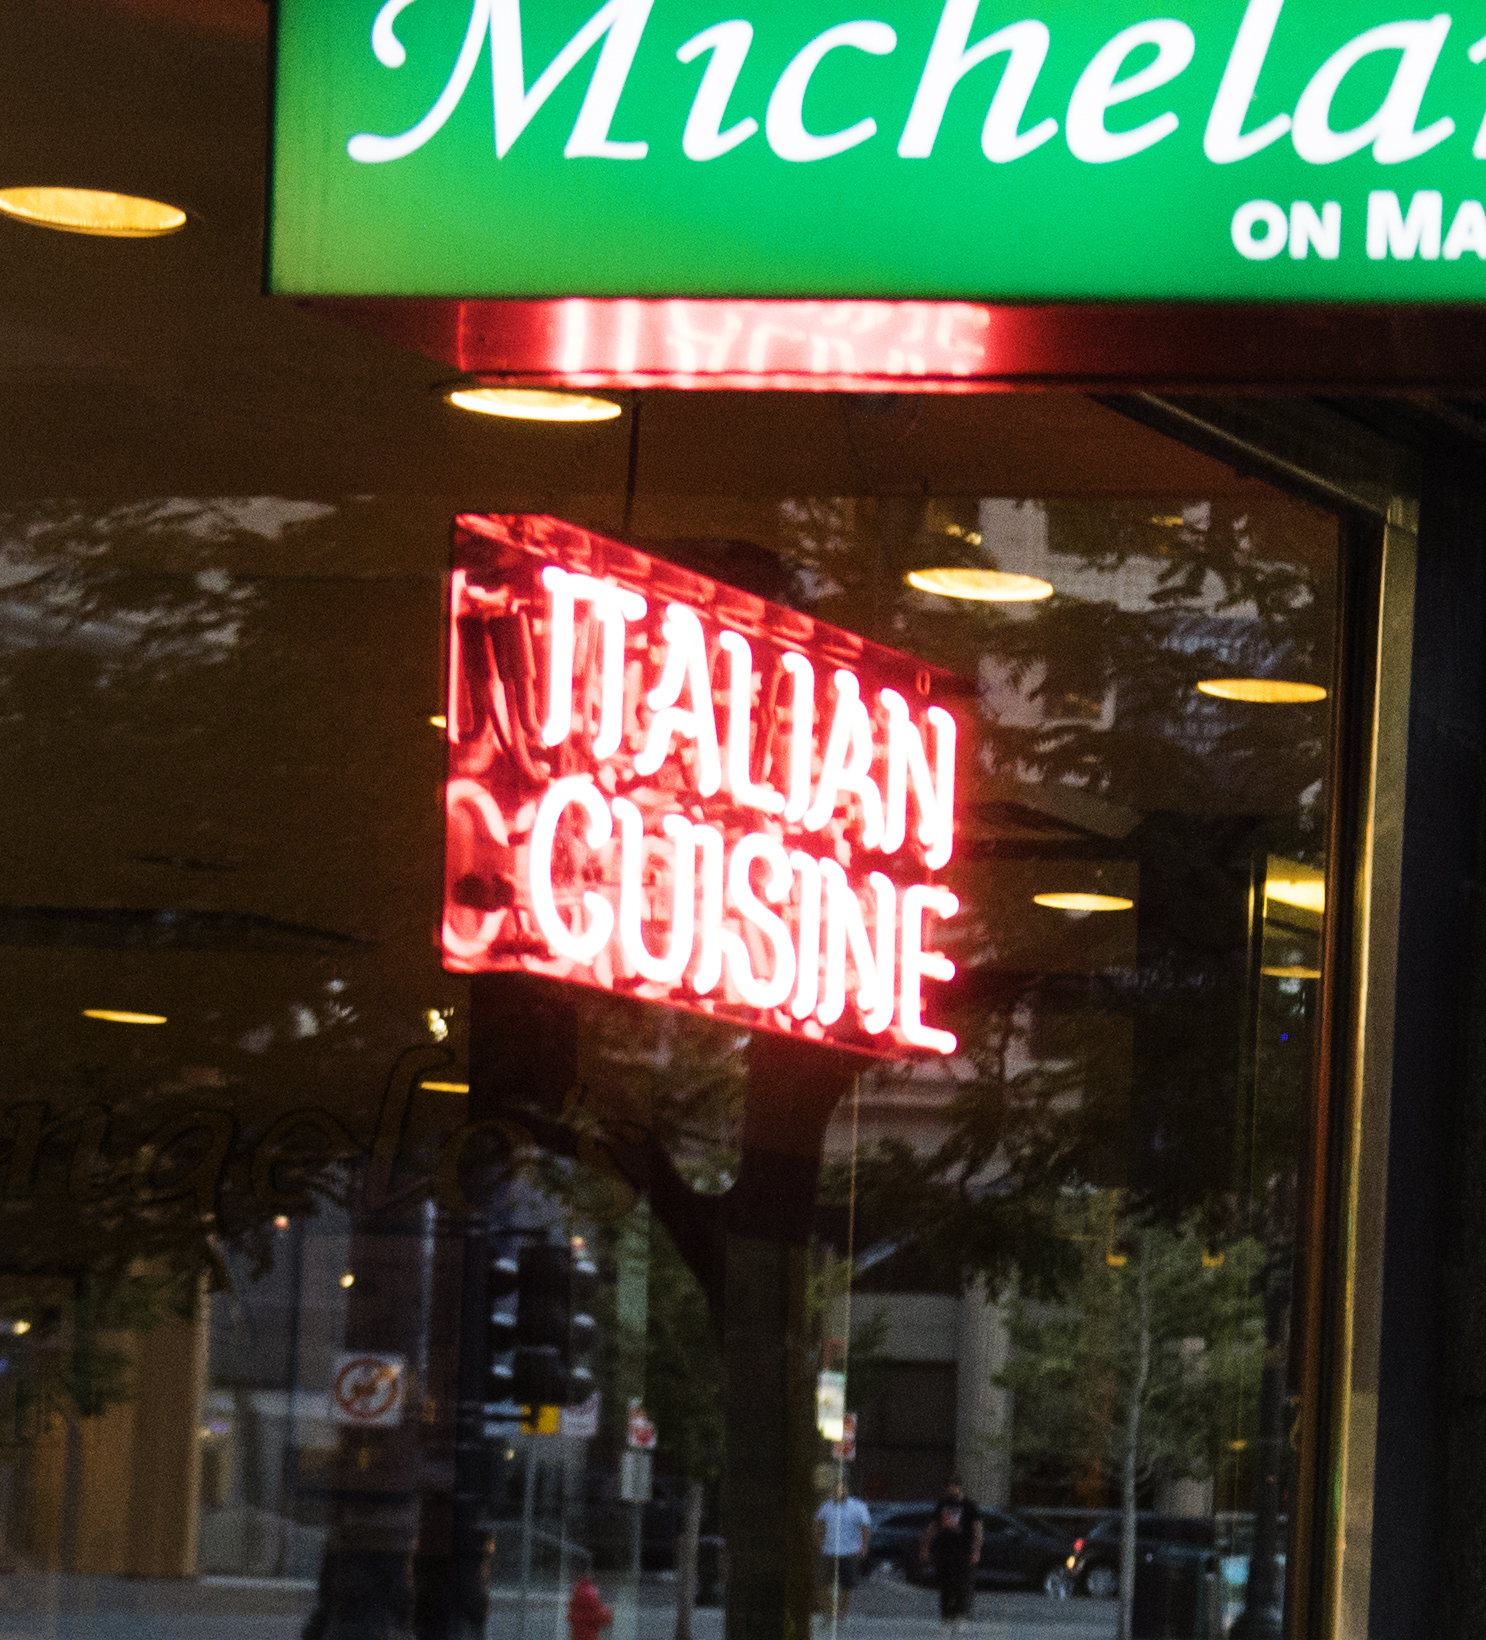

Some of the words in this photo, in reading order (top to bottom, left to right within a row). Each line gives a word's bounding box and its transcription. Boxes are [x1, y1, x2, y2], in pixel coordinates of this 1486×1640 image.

[1230, 198, 1342, 262] ON
[541, 565, 957, 870] ITALIAN
[528, 776, 960, 1055] CUISINE
